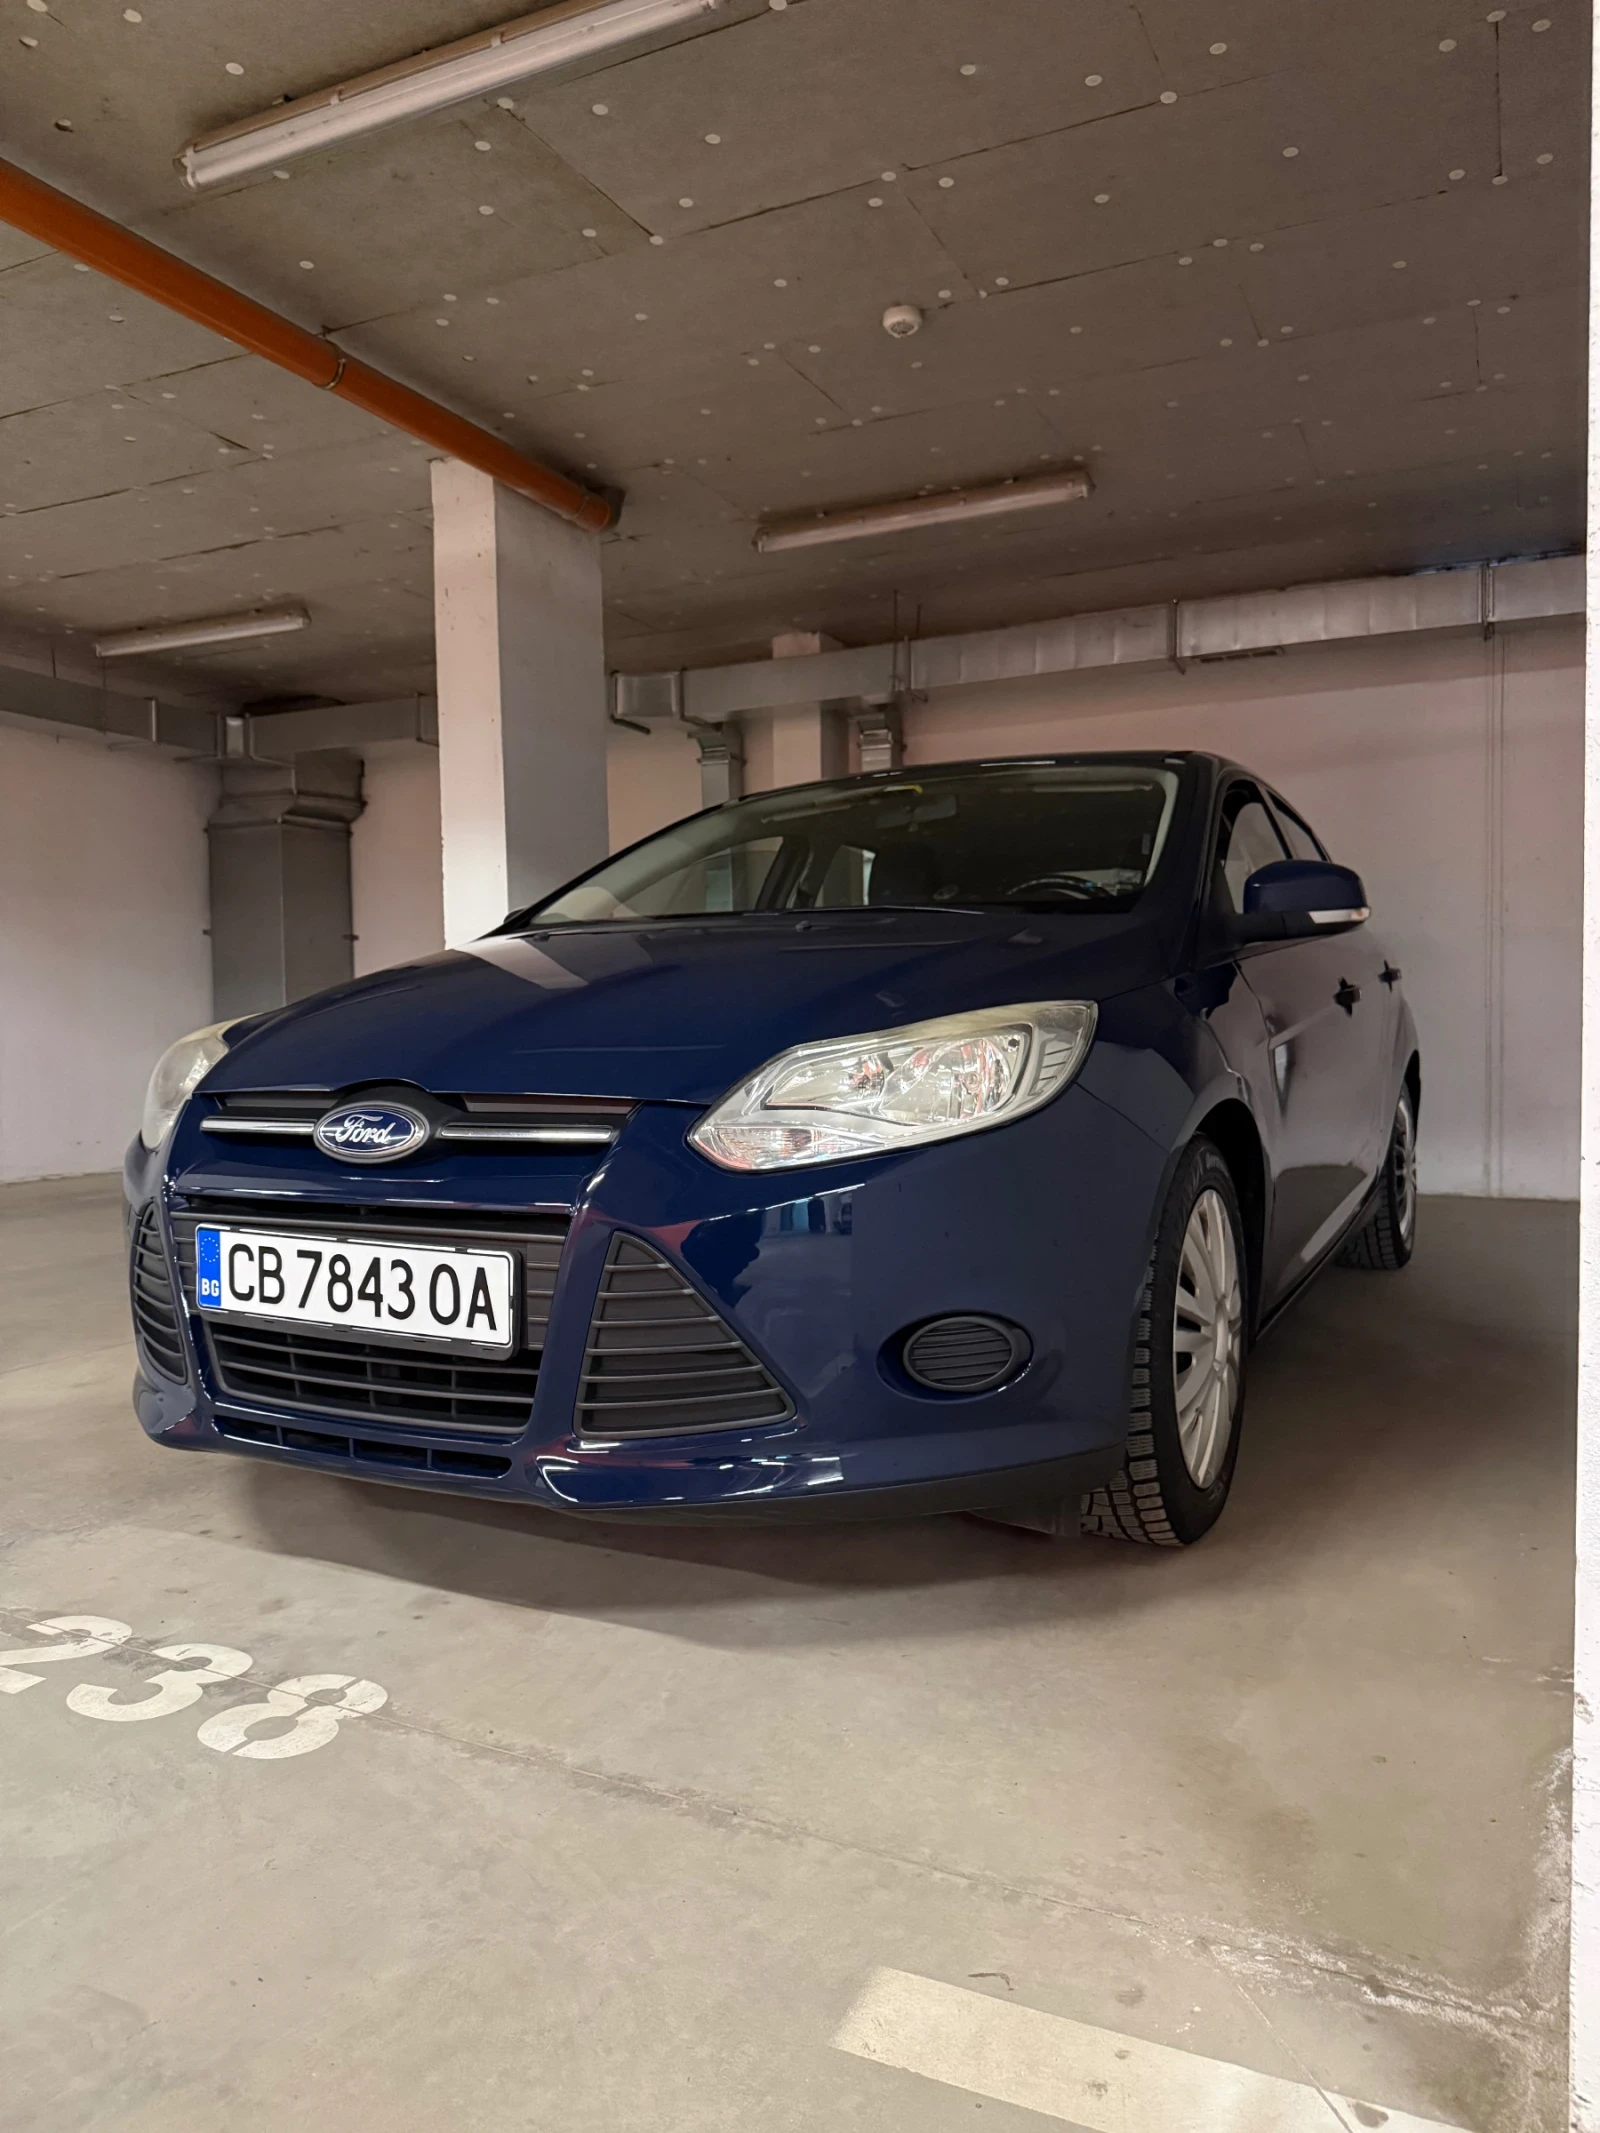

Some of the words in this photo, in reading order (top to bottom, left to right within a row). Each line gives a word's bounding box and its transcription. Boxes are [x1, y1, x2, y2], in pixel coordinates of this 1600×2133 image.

[335, 1114, 396, 1144] Ford
[201, 1277, 220, 1297] BG
[228, 1243, 285, 1304] CB
[296, 1249, 416, 1320] 7843
